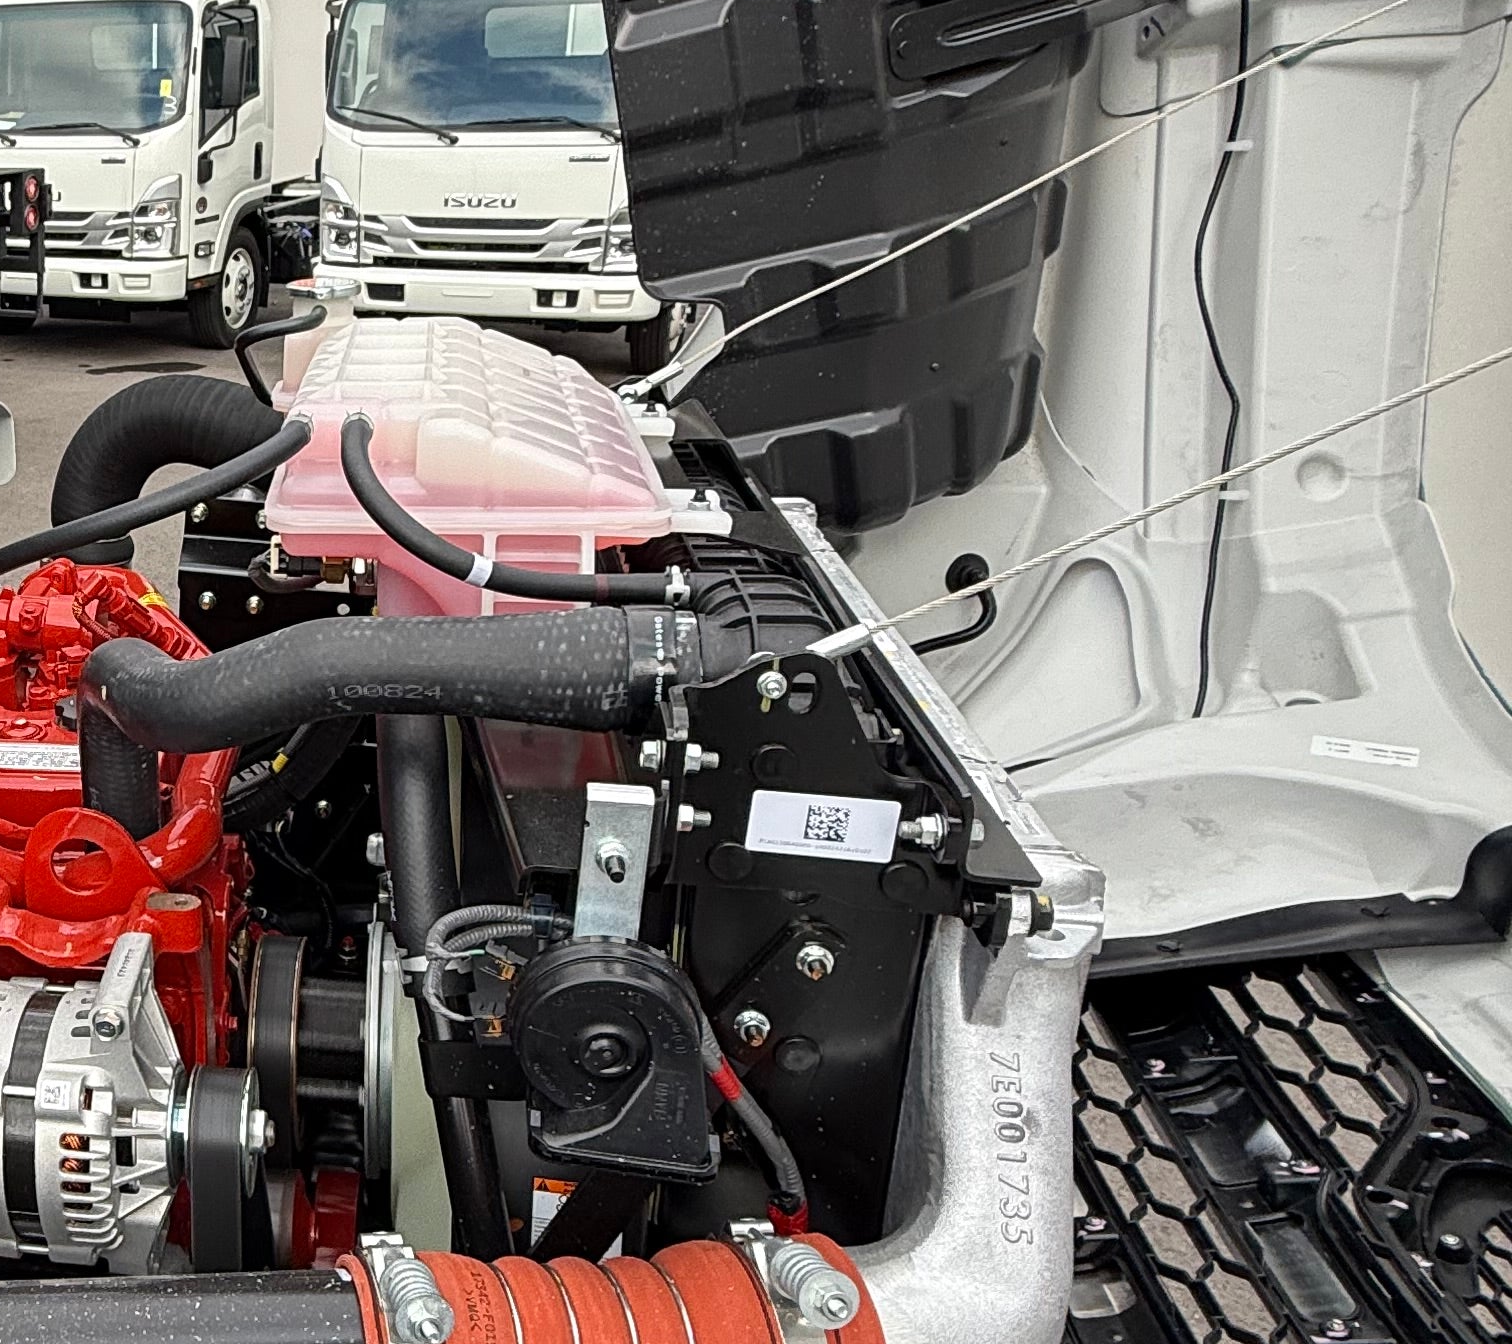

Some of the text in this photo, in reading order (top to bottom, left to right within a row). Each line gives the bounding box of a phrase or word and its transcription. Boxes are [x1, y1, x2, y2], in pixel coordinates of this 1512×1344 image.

[443, 193, 517, 208] ISUZU
[328, 683, 441, 700] 100824
[989, 1051, 1034, 1245] 7E001735
